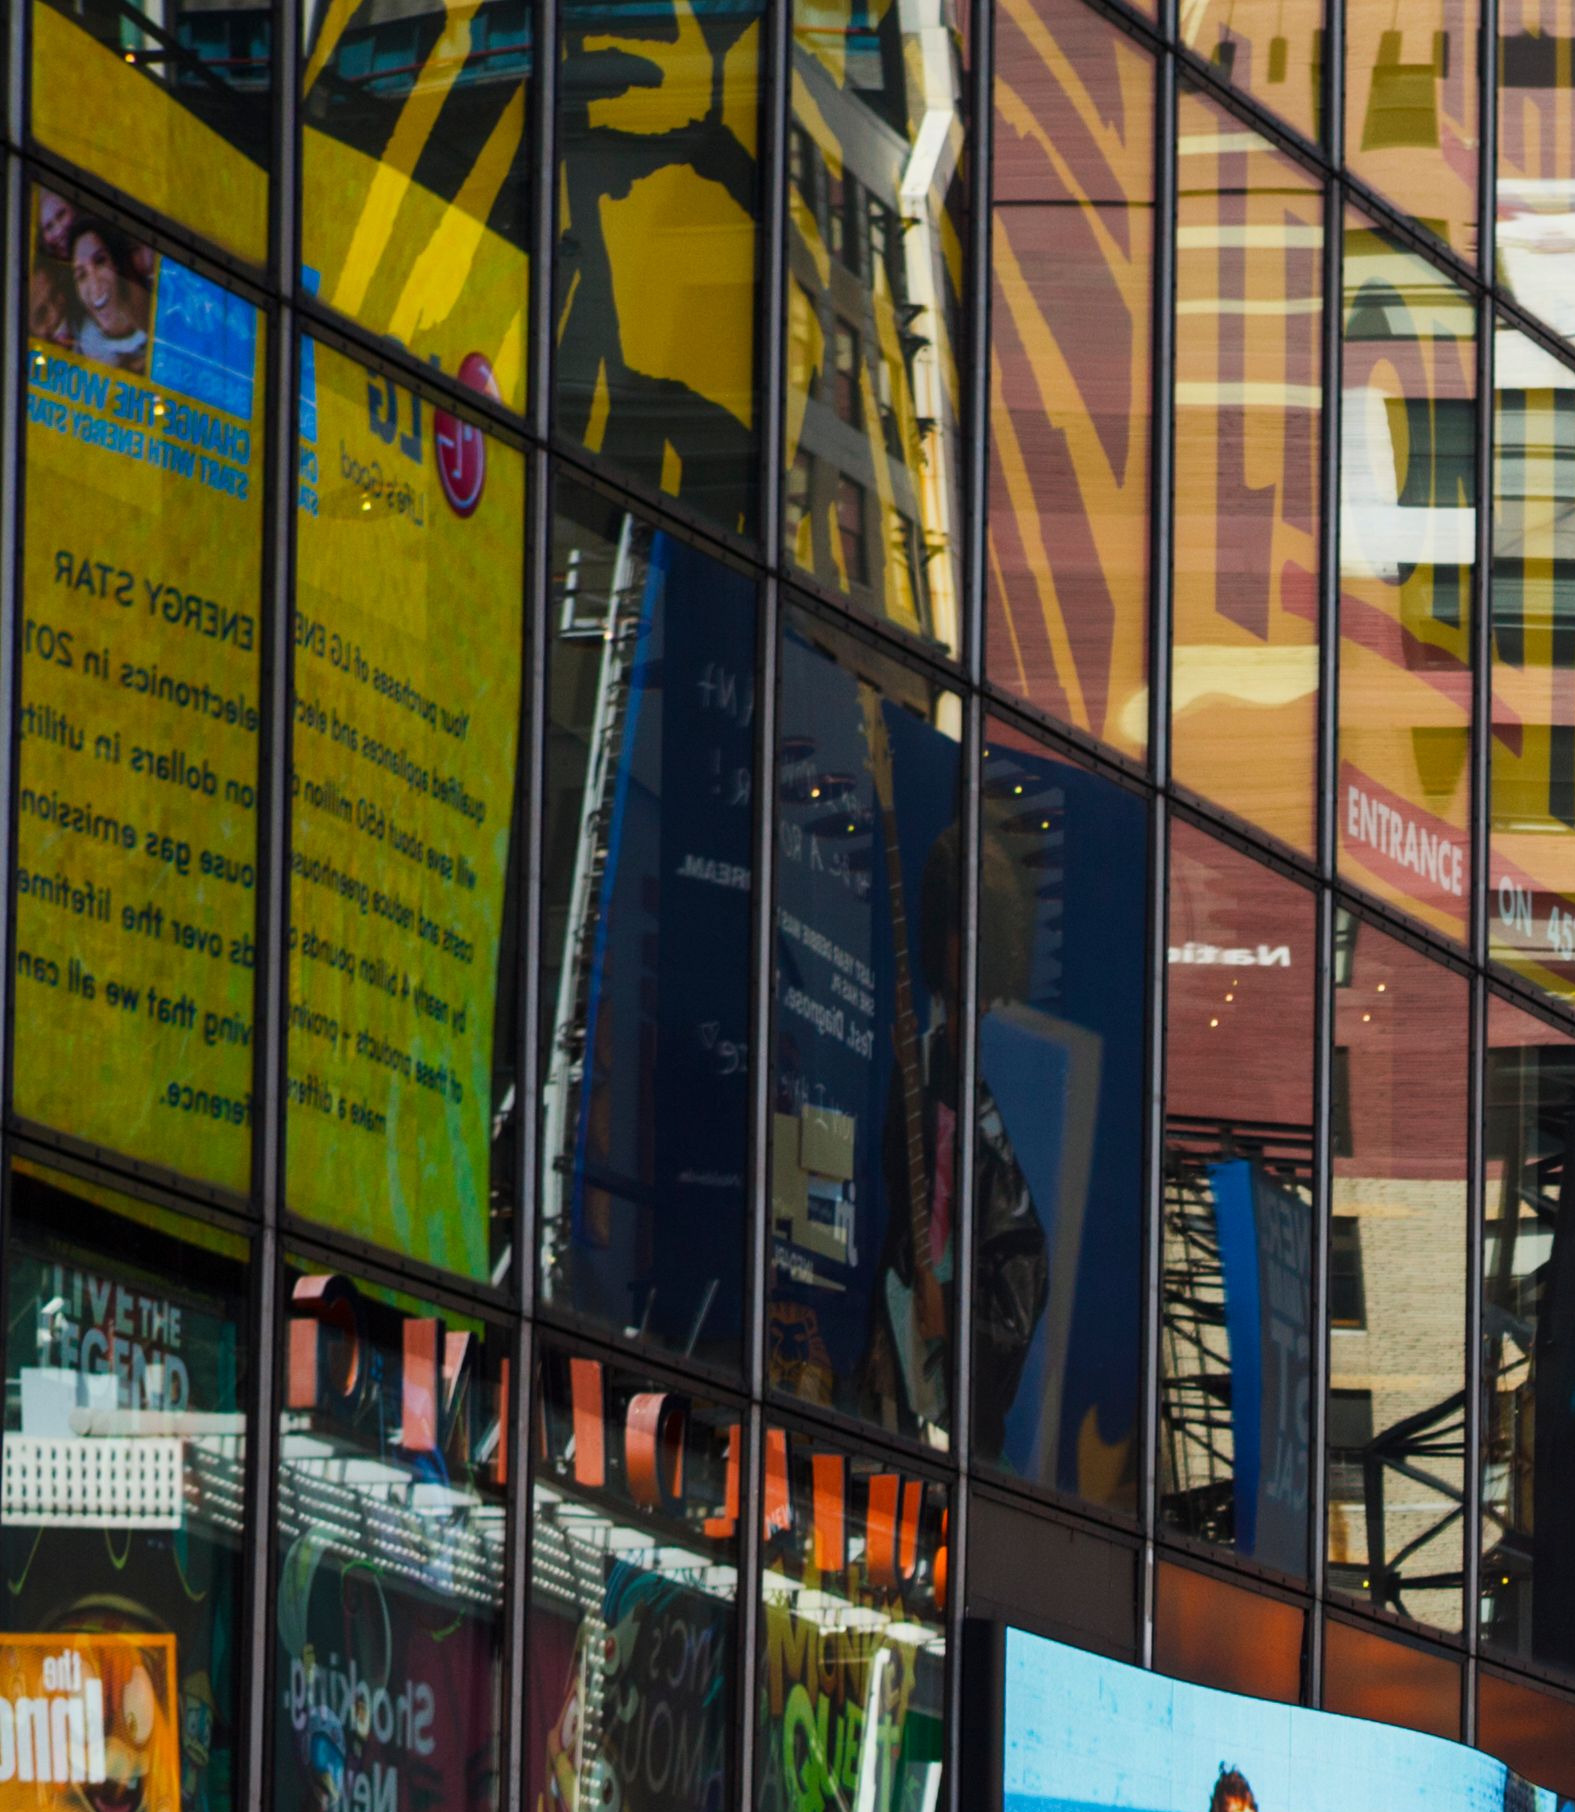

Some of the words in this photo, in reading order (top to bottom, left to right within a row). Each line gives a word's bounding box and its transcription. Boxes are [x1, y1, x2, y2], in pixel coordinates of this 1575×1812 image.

[1345, 782, 1465, 899] ENTRANCE
[1497, 875, 1534, 939] ON
[138, 1298, 181, 1348] THE
